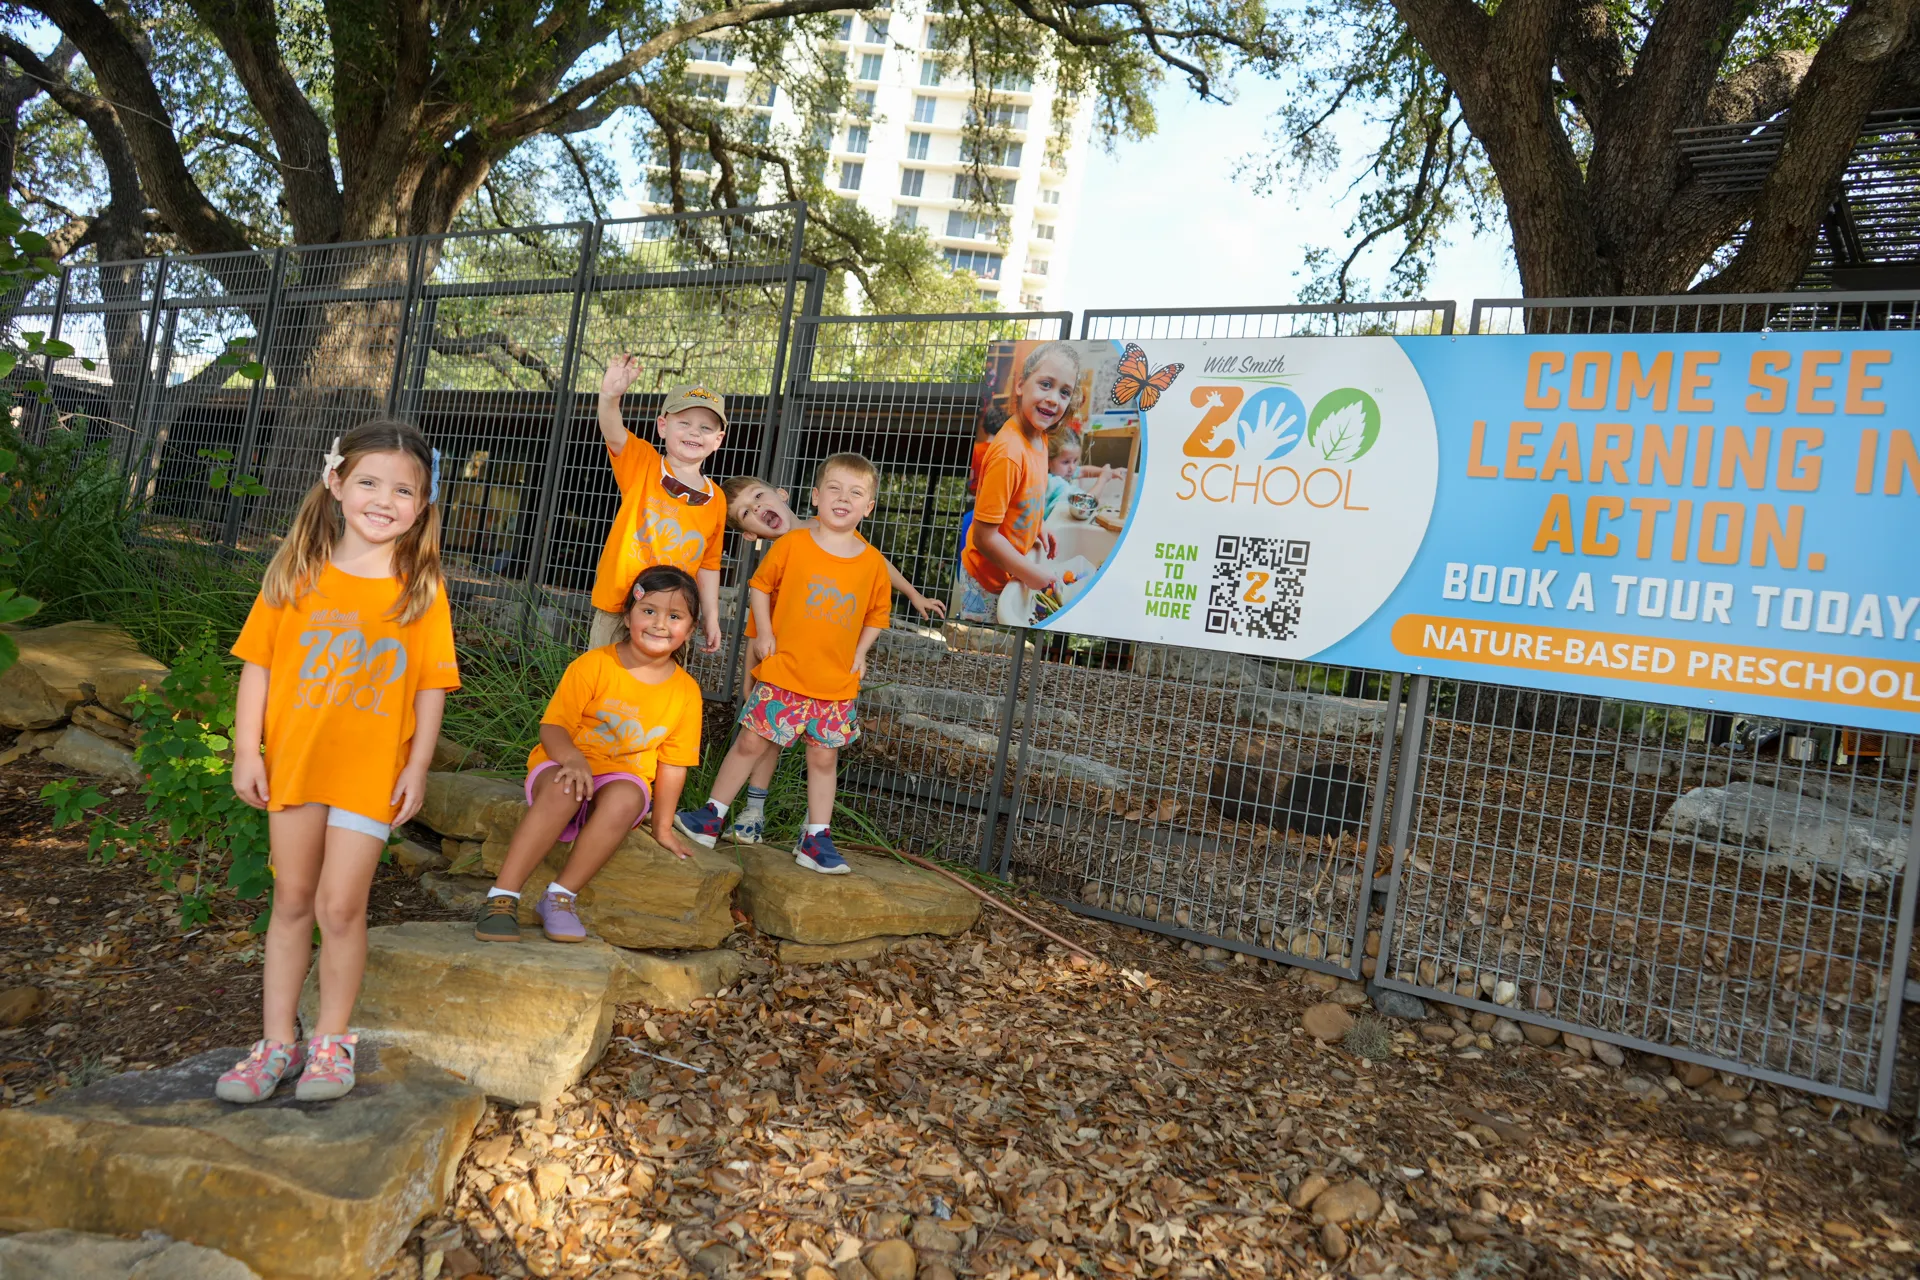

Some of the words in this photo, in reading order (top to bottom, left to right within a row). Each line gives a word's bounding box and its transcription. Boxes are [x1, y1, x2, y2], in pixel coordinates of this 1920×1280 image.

[1203, 355, 1239, 374] Will
[1238, 354, 1286, 374] Smith
[1524, 351, 1721, 412] COME
[1745, 350, 1892, 415] SEE
[1182, 386, 1381, 464] ZOO
[1466, 420, 1825, 493] LEARNING
[1854, 428, 1920, 496] IN
[1175, 462, 1370, 511] SCHOOL
[1155, 542, 1198, 561] SCAN
[1531, 493, 1826, 571] ACTION.
[1144, 580, 1197, 601] LEARN
[1164, 562, 1184, 580] TO
[1442, 562, 1558, 609] BOOK
[1566, 572, 1595, 612] A
[1611, 575, 1734, 624] TOUR
[1145, 600, 1192, 620] MORE
[1422, 624, 1677, 675] NATURE-BASED
[1687, 651, 1920, 702] PRESCHOOL
